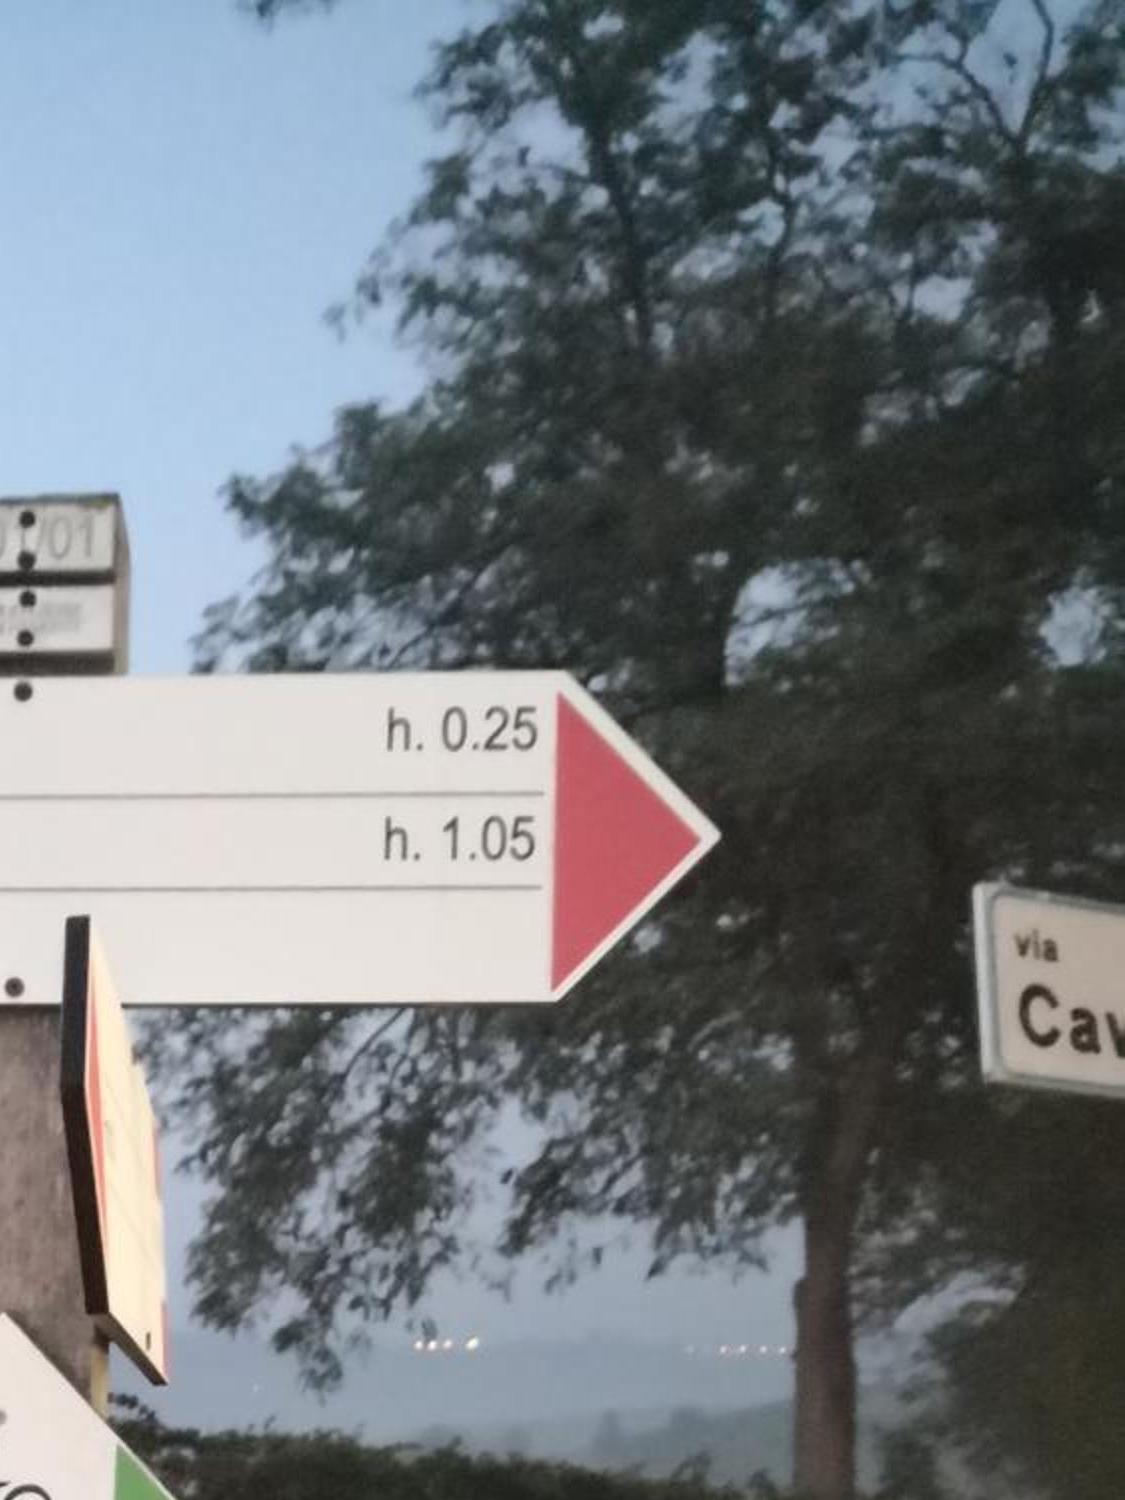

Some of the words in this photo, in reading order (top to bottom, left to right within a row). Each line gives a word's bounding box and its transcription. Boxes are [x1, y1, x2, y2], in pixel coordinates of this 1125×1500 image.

[386, 707, 424, 752] h.
[441, 705, 538, 753] 0.25
[383, 815, 421, 861] h.
[442, 815, 536, 862] 1.05
[1013, 929, 1059, 963] via
